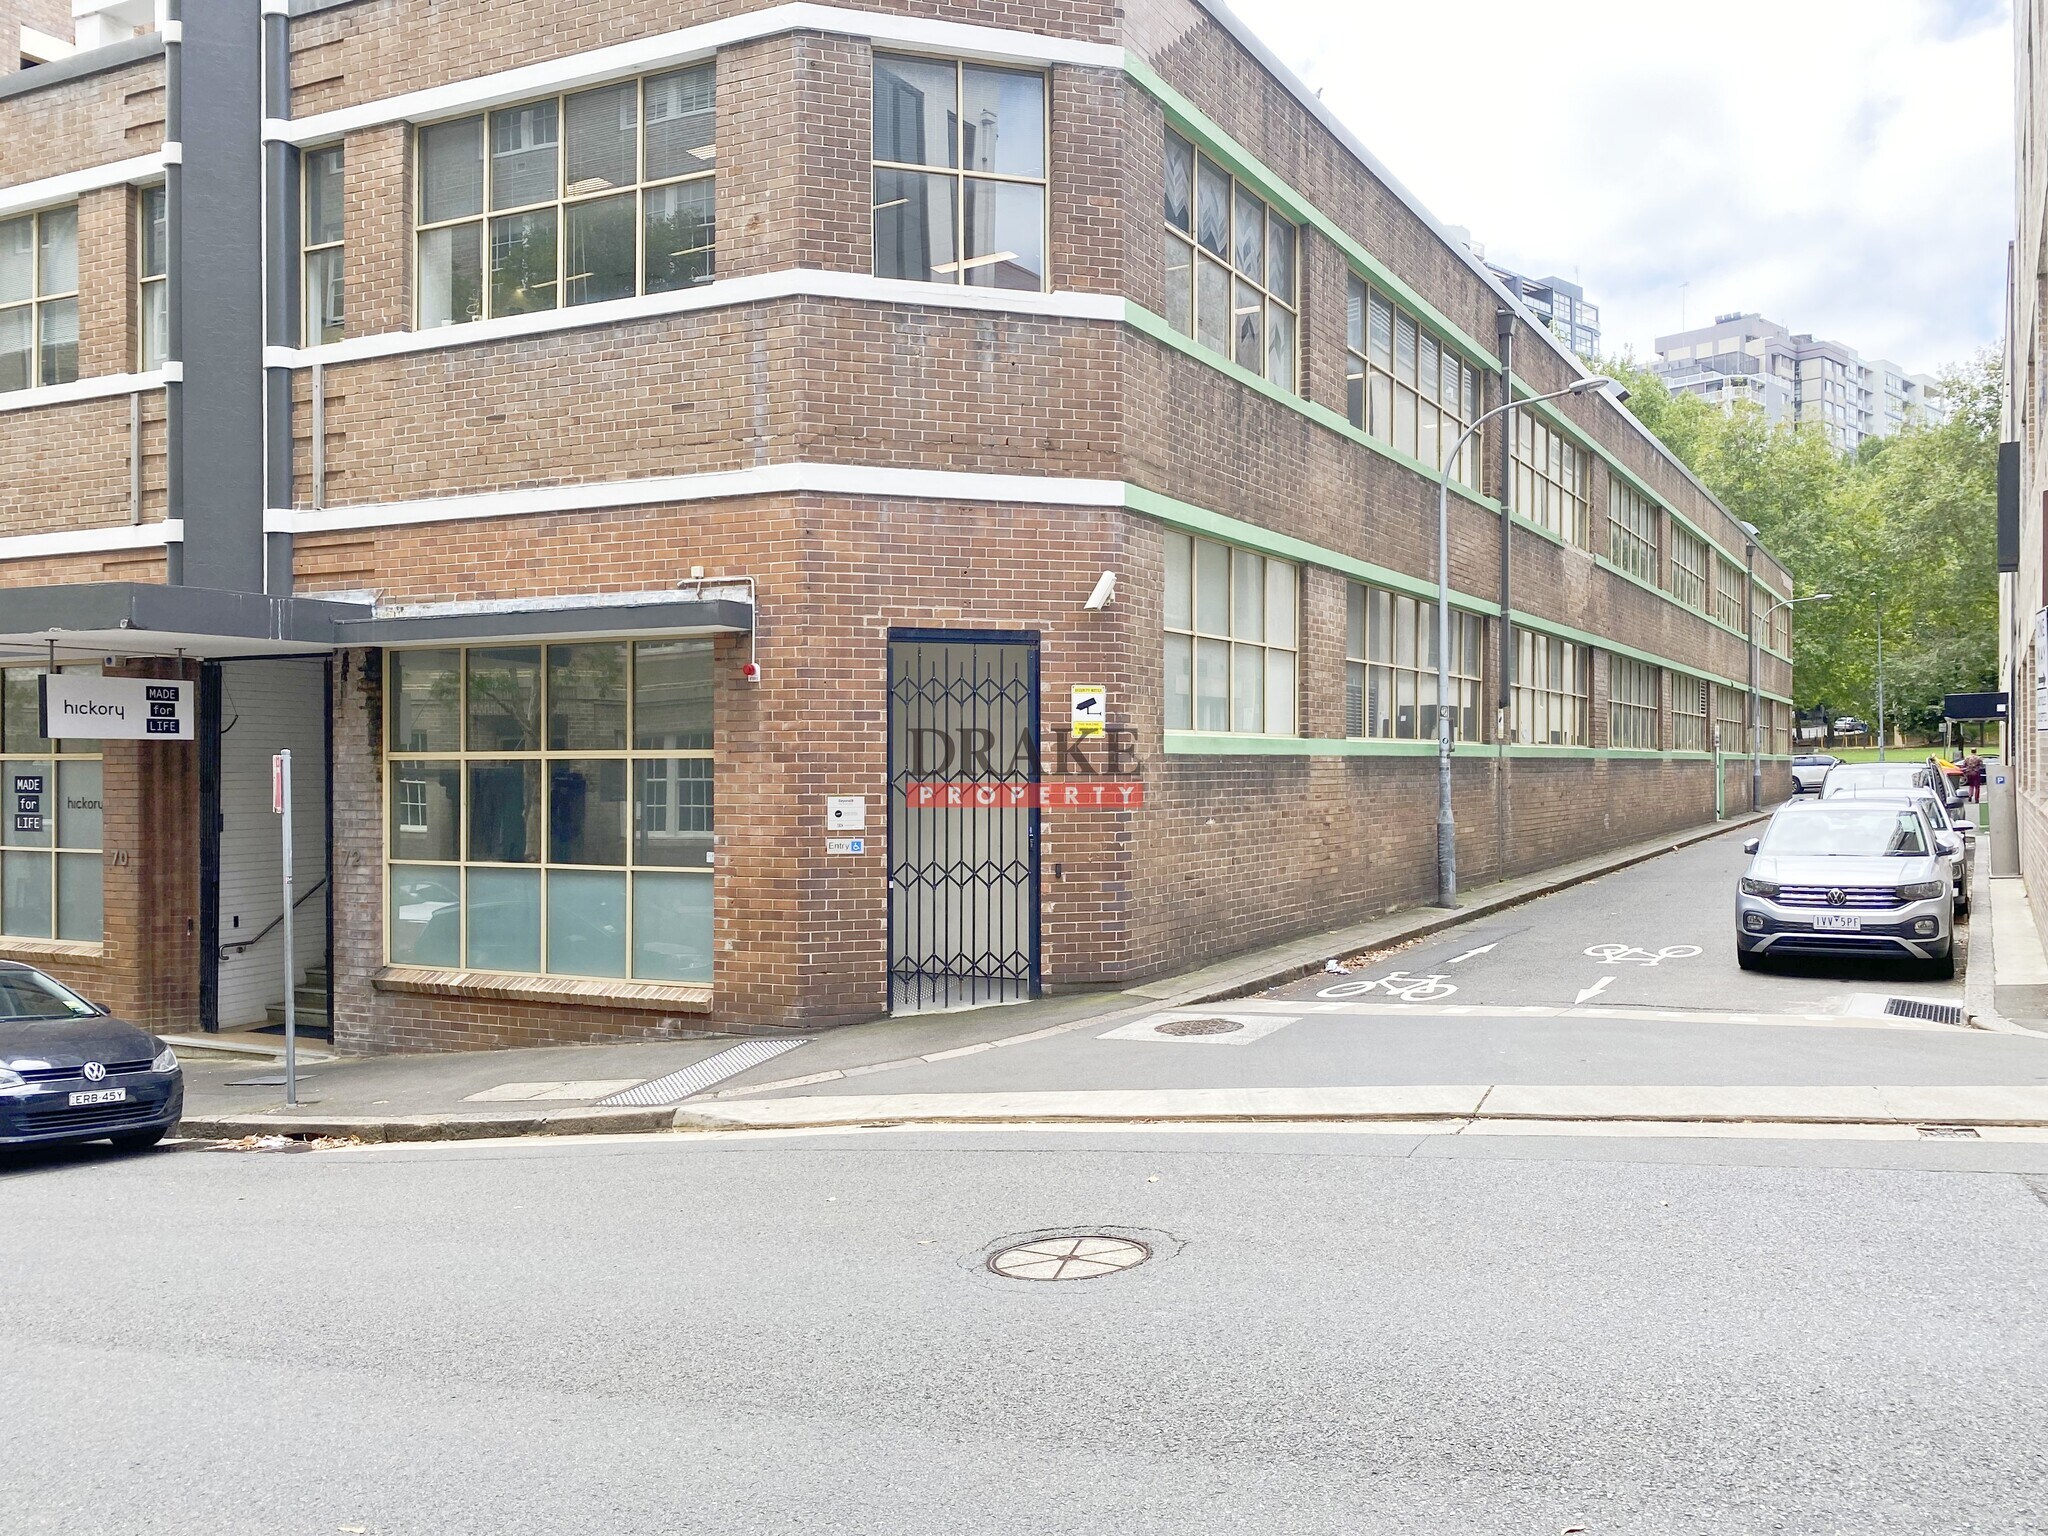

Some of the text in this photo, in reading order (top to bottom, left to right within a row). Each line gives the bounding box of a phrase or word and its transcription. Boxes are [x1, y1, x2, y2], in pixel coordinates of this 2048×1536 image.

[149, 687, 176, 699] MADE
[63, 699, 125, 720] hickory
[153, 705, 173, 715] for
[149, 721, 176, 732] LIFE
[16, 779, 40, 791] MADE
[19, 798, 37, 809] for
[16, 816, 40, 828] LIFE
[828, 841, 850, 850] Entry
[110, 849, 128, 866] 70
[341, 849, 360, 866] 72
